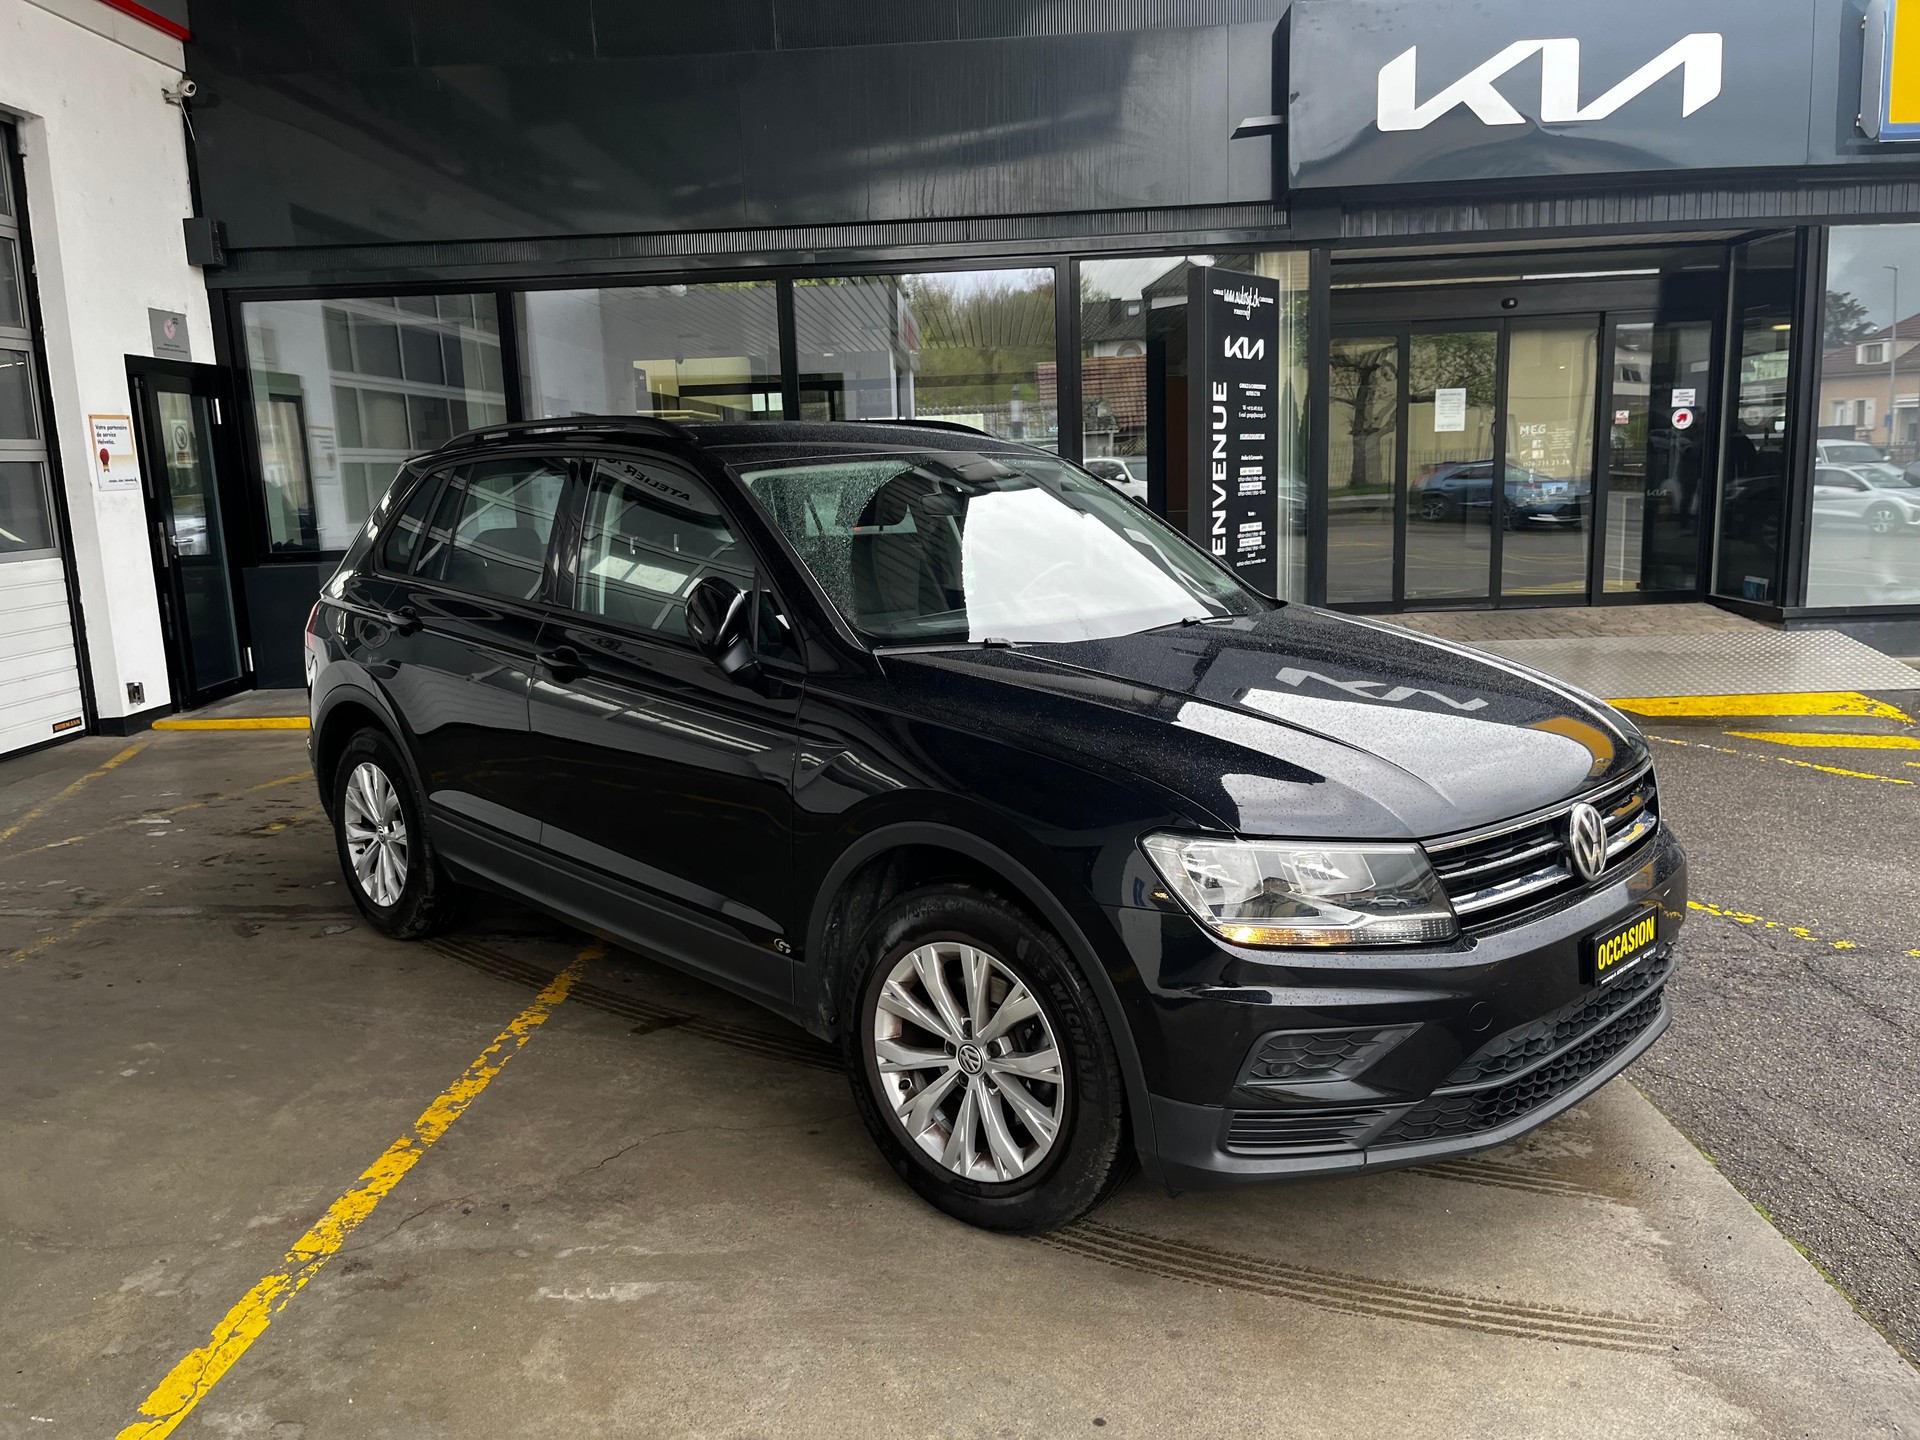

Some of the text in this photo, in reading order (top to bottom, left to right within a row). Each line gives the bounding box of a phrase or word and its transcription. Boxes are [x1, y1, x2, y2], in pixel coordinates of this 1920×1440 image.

[1377, 33, 1723, 131] KIA
[1224, 335, 1265, 361] KIA
[1598, 915, 1655, 970] OCCASION
